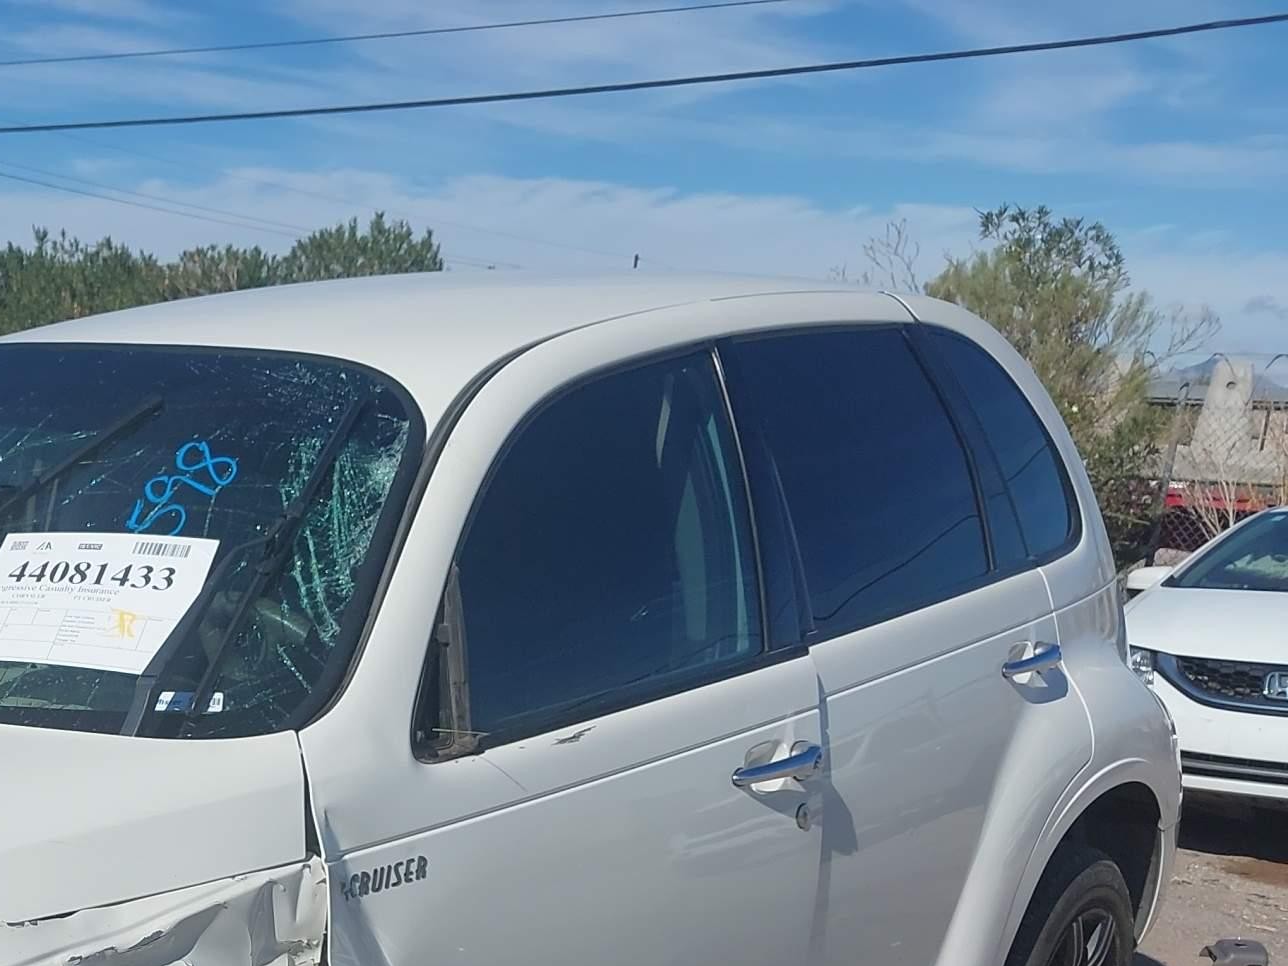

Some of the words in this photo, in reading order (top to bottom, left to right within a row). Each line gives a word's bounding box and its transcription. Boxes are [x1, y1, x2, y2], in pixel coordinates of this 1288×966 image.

[126, 440, 238, 536] 598
[7, 560, 176, 591] 44081433
[39, 585, 75, 594] Casualty
[77, 587, 120, 596] Insurance
[350, 855, 428, 897] CRUISER
